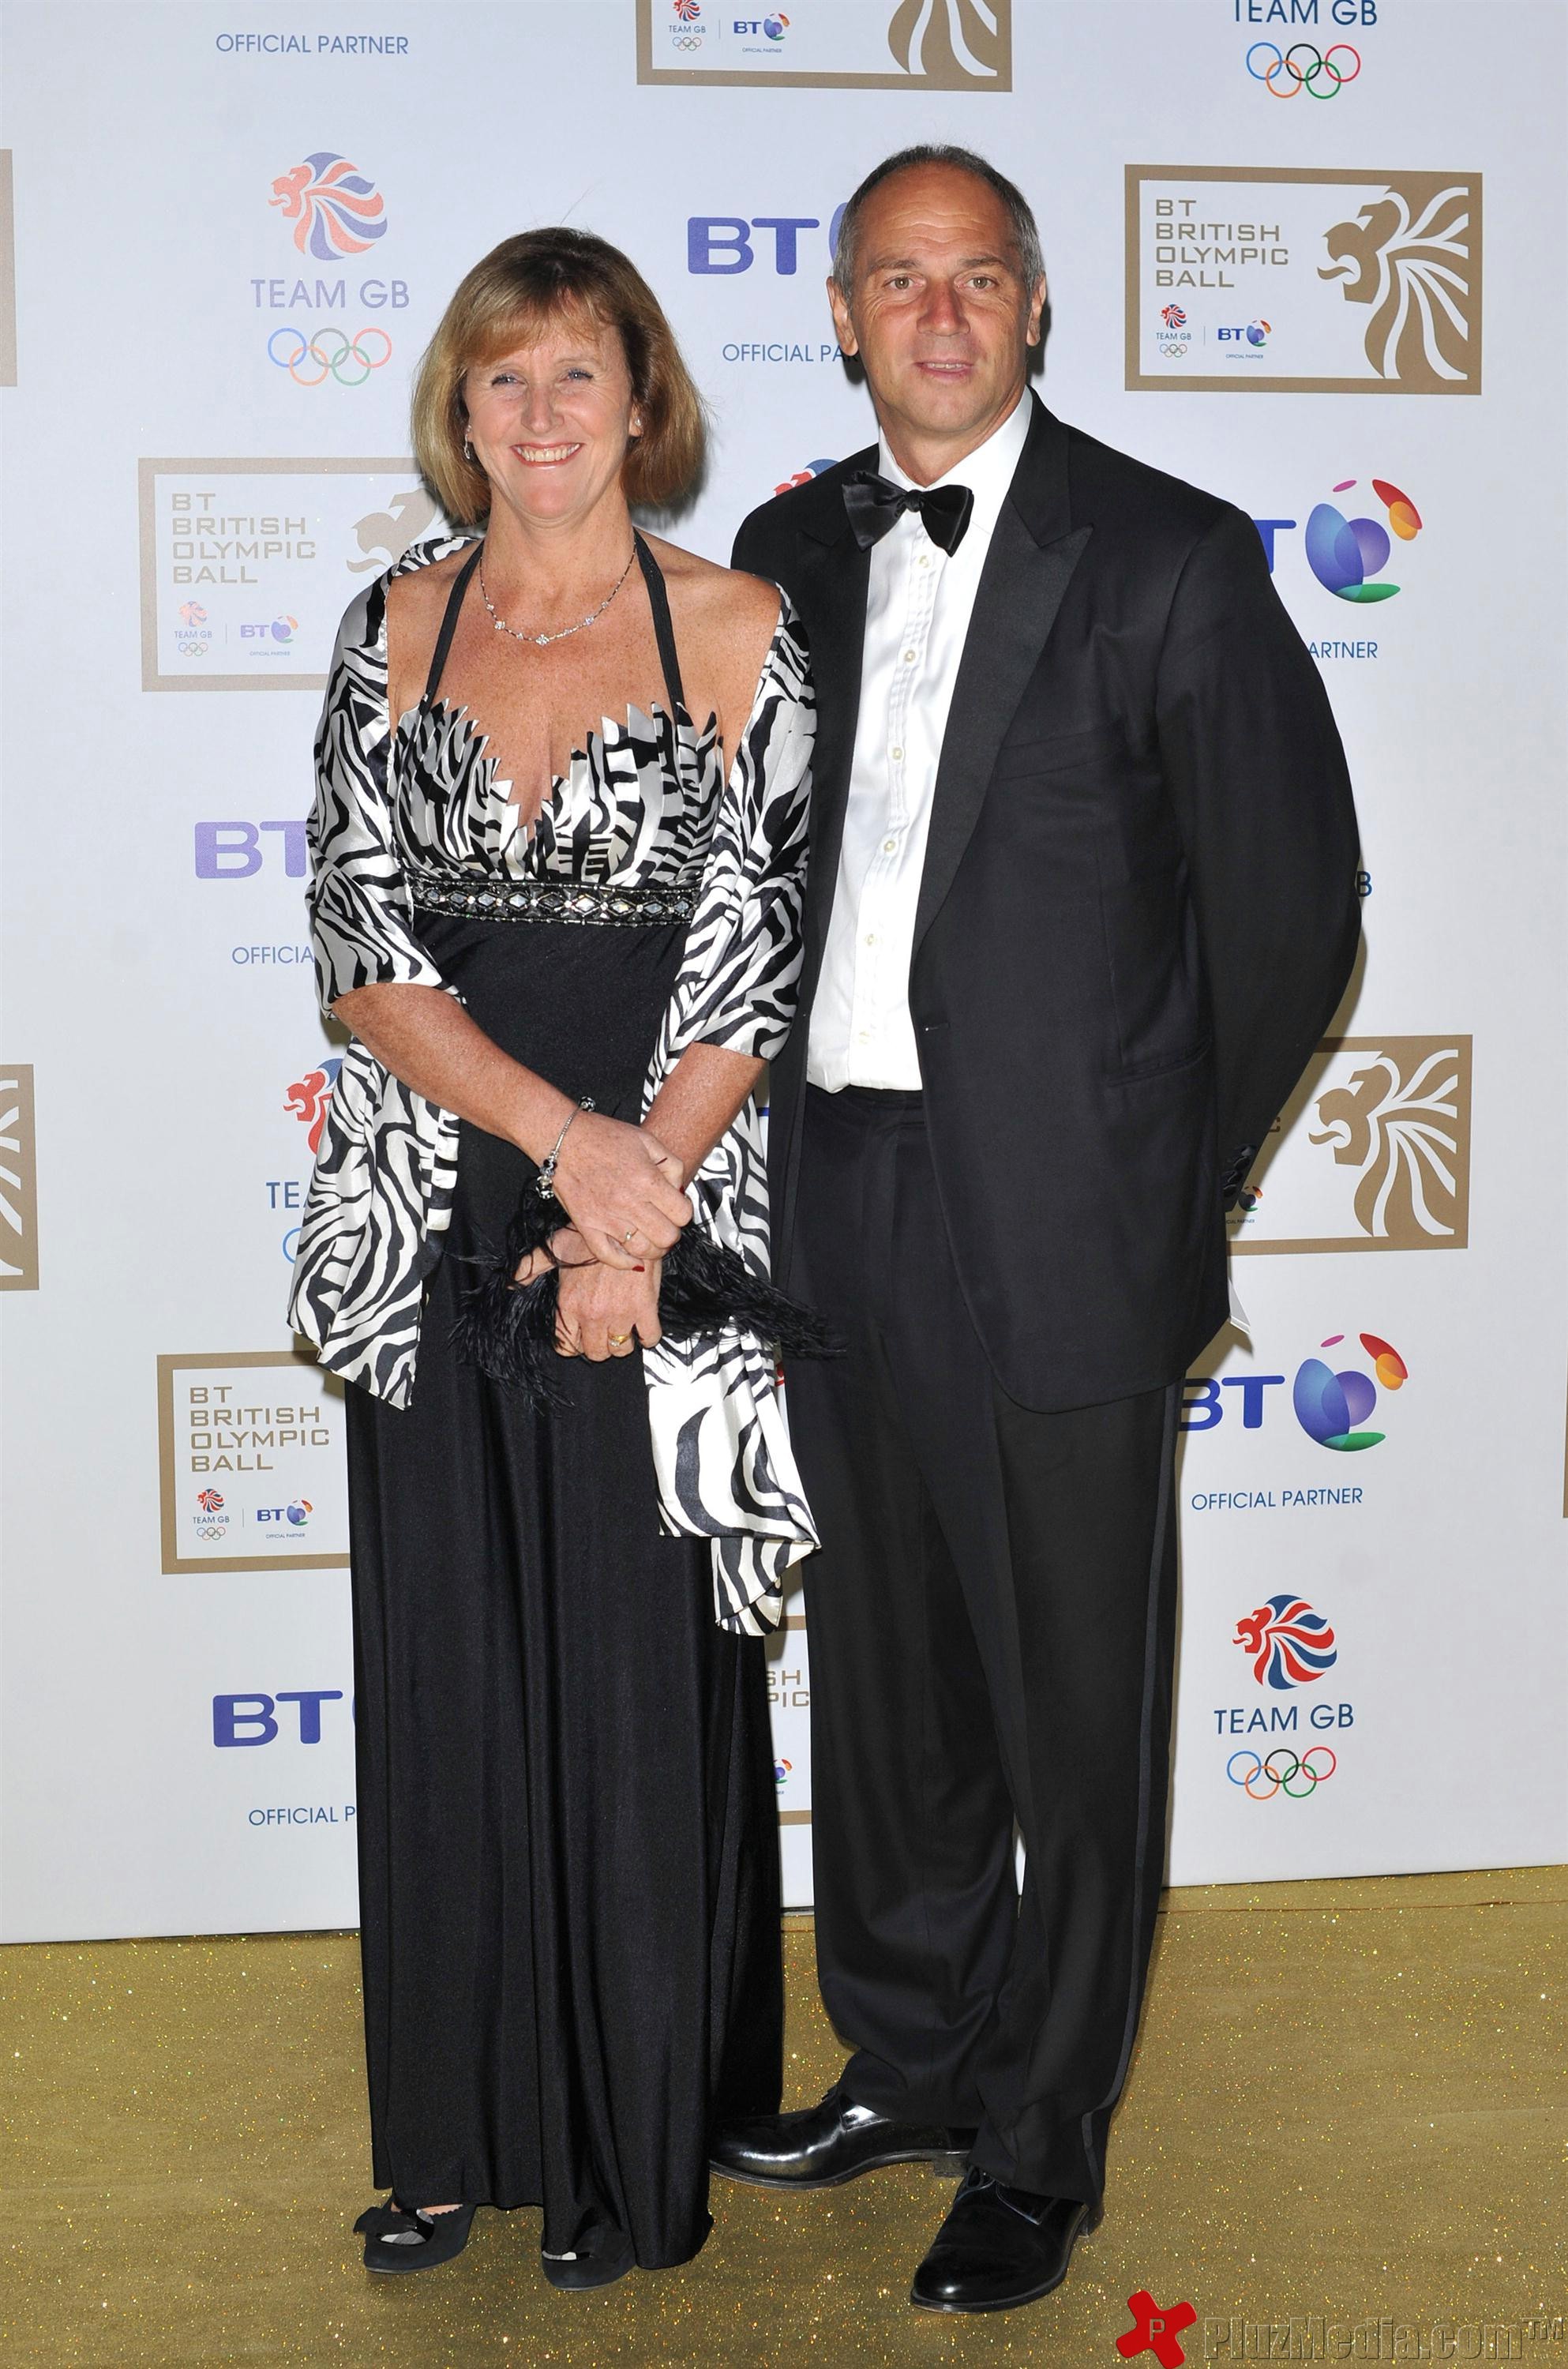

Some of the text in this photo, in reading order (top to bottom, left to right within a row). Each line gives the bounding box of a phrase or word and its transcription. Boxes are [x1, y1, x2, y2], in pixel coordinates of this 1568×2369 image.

[1235, 0, 1378, 26] TEAM GB
[733, 21, 762, 35] BT
[216, 33, 409, 54] OFFICIAL PARTNER
[1156, 199, 1197, 217] BT
[1155, 222, 1280, 242] BRITISH
[687, 216, 820, 276] BT
[1156, 246, 1289, 265] OLYMPIC
[1156, 269, 1235, 288] BALL
[249, 278, 410, 309] TEAM GB
[1156, 332, 1192, 341] TEAM GB
[1217, 328, 1245, 341] BT
[722, 344, 815, 362] OFFICIAL
[171, 493, 216, 512] BT
[172, 516, 306, 535] BRITISH
[172, 541, 317, 560] OLYMPIC
[173, 565, 258, 584] BALL
[240, 624, 270, 638] BT
[194, 820, 307, 880] BT
[266, 1181, 308, 1208] TE
[189, 1386, 233, 1404] BT
[1178, 1376, 1285, 1432] BT
[190, 1406, 320, 1427] BRITISH
[190, 1429, 329, 1450] OLYMPIC
[191, 1453, 274, 1473] BALL
[1191, 1487, 1363, 1511] OFFICIAL PARTNER
[193, 1515, 216, 1524] TEAM
[257, 1508, 285, 1522] BT
[212, 1690, 343, 1748] BT
[1214, 1703, 1354, 1735] TEAM GB
[248, 1806, 339, 1826] OFFICIAL
